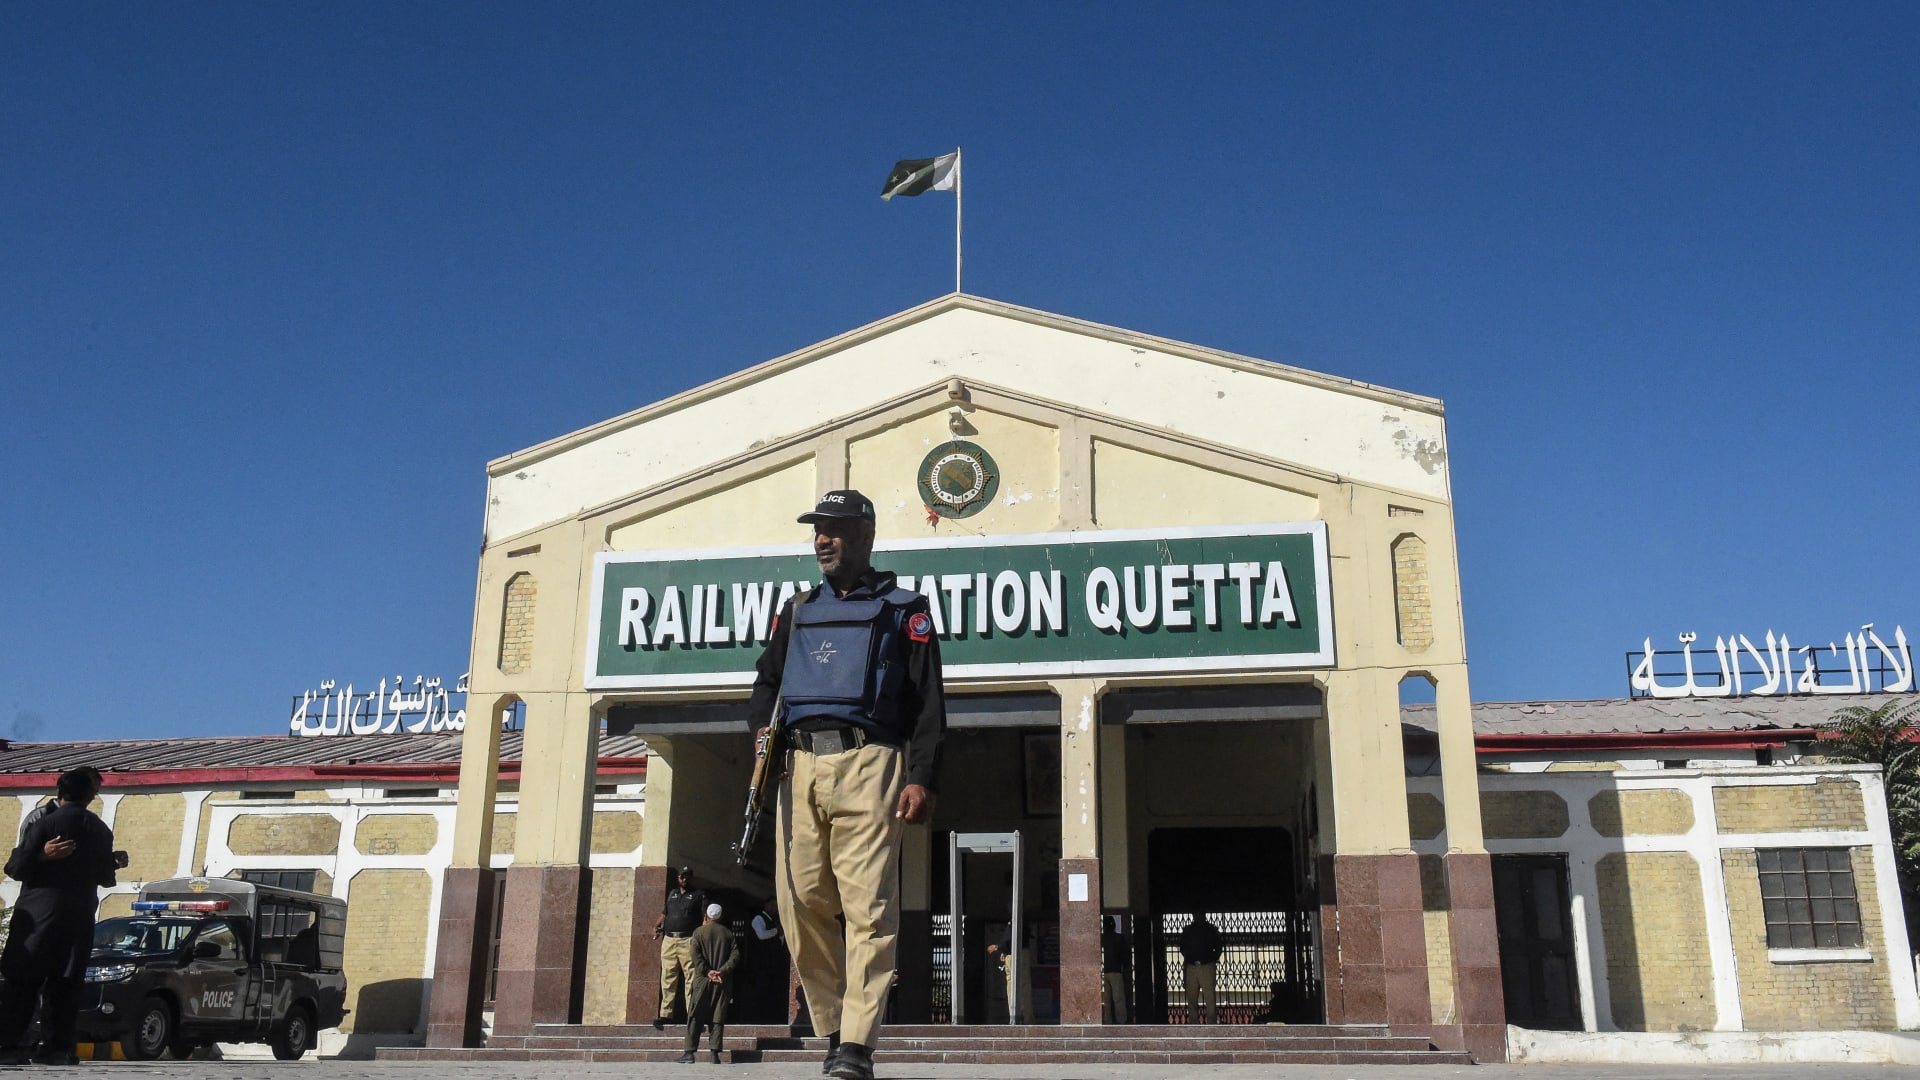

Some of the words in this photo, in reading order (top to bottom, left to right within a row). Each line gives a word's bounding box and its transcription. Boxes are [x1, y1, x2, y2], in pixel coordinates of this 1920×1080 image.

[819, 495, 846, 504] OLICE
[618, 580, 824, 645] RAILW
[897, 568, 1062, 634] ATION
[1085, 560, 1297, 633] QUETTA
[202, 991, 234, 1008] POLICE
